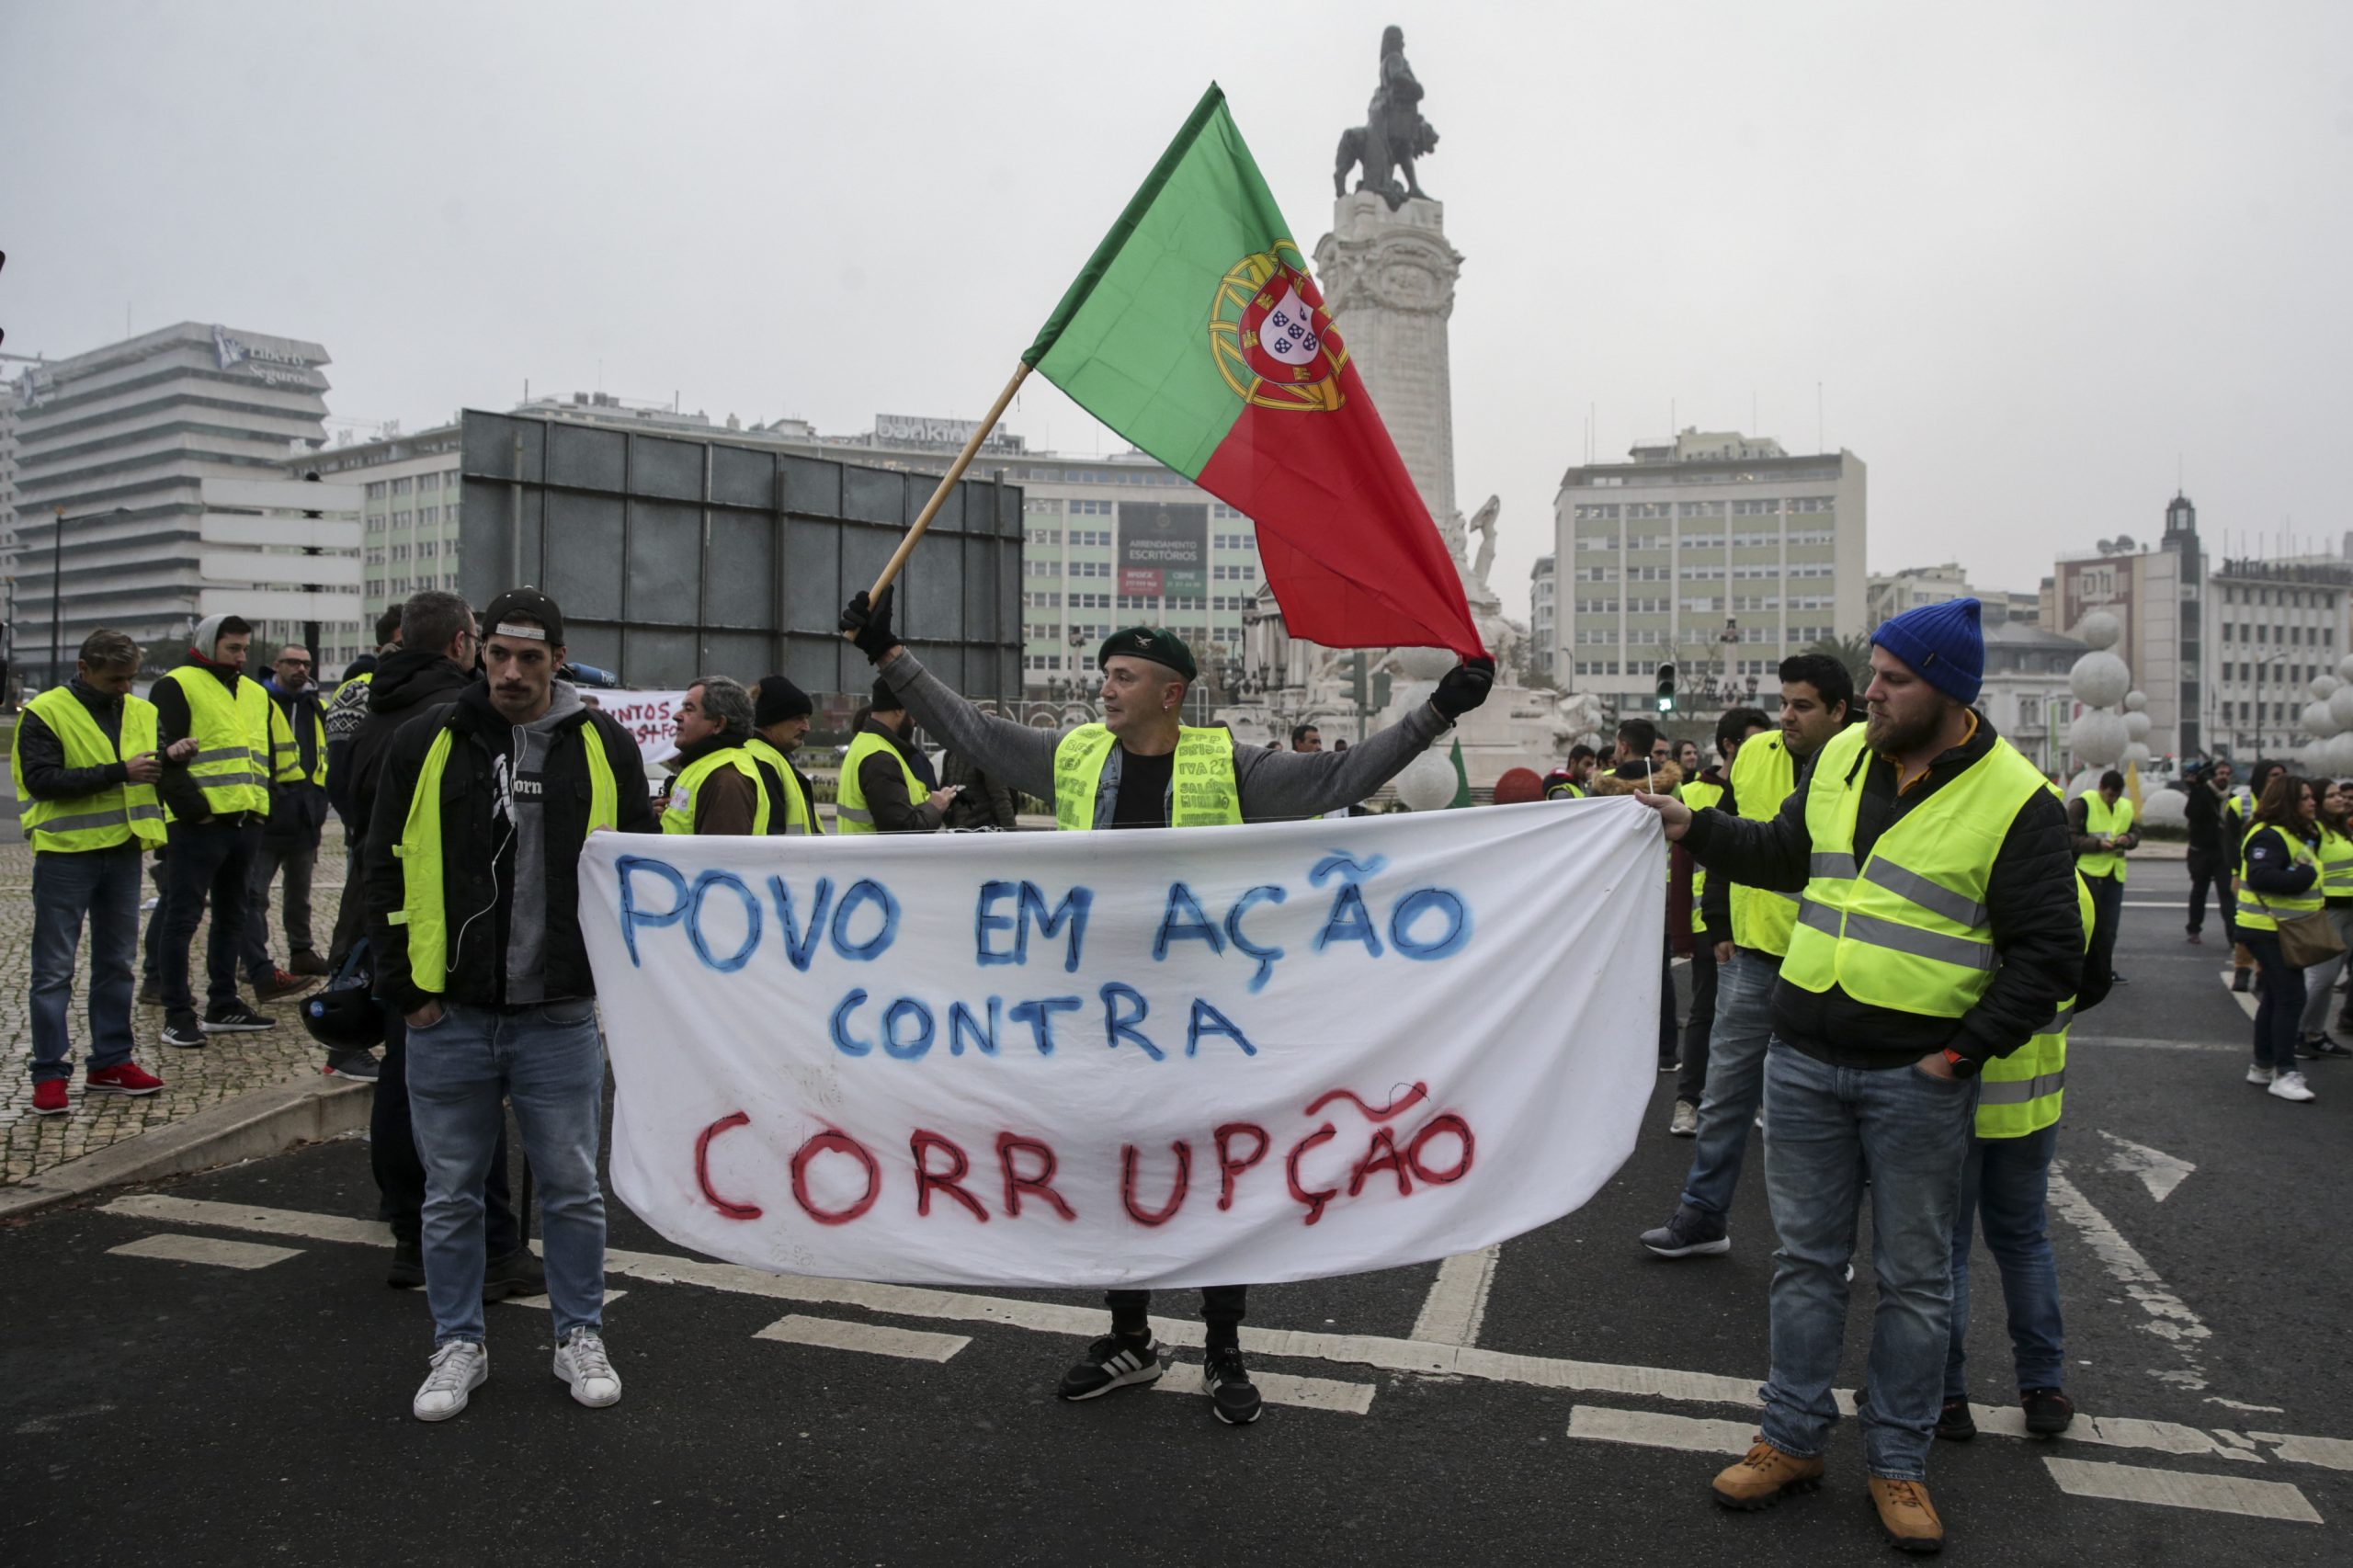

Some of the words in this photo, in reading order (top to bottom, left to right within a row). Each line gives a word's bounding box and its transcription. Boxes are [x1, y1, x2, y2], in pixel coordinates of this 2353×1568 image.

[249, 345, 305, 368] Liberty
[248, 364, 311, 385] Seguros
[1129, 549, 1199, 562] ESCRITÓRIOS
[1178, 761, 1208, 776] IVA
[613, 851, 903, 974] POVO
[972, 878, 1096, 974] EM
[1151, 847, 1474, 994] AÇÃO
[828, 980, 1259, 1063] CONTRA
[694, 1080, 1476, 1229] CORRUPÇÃO
